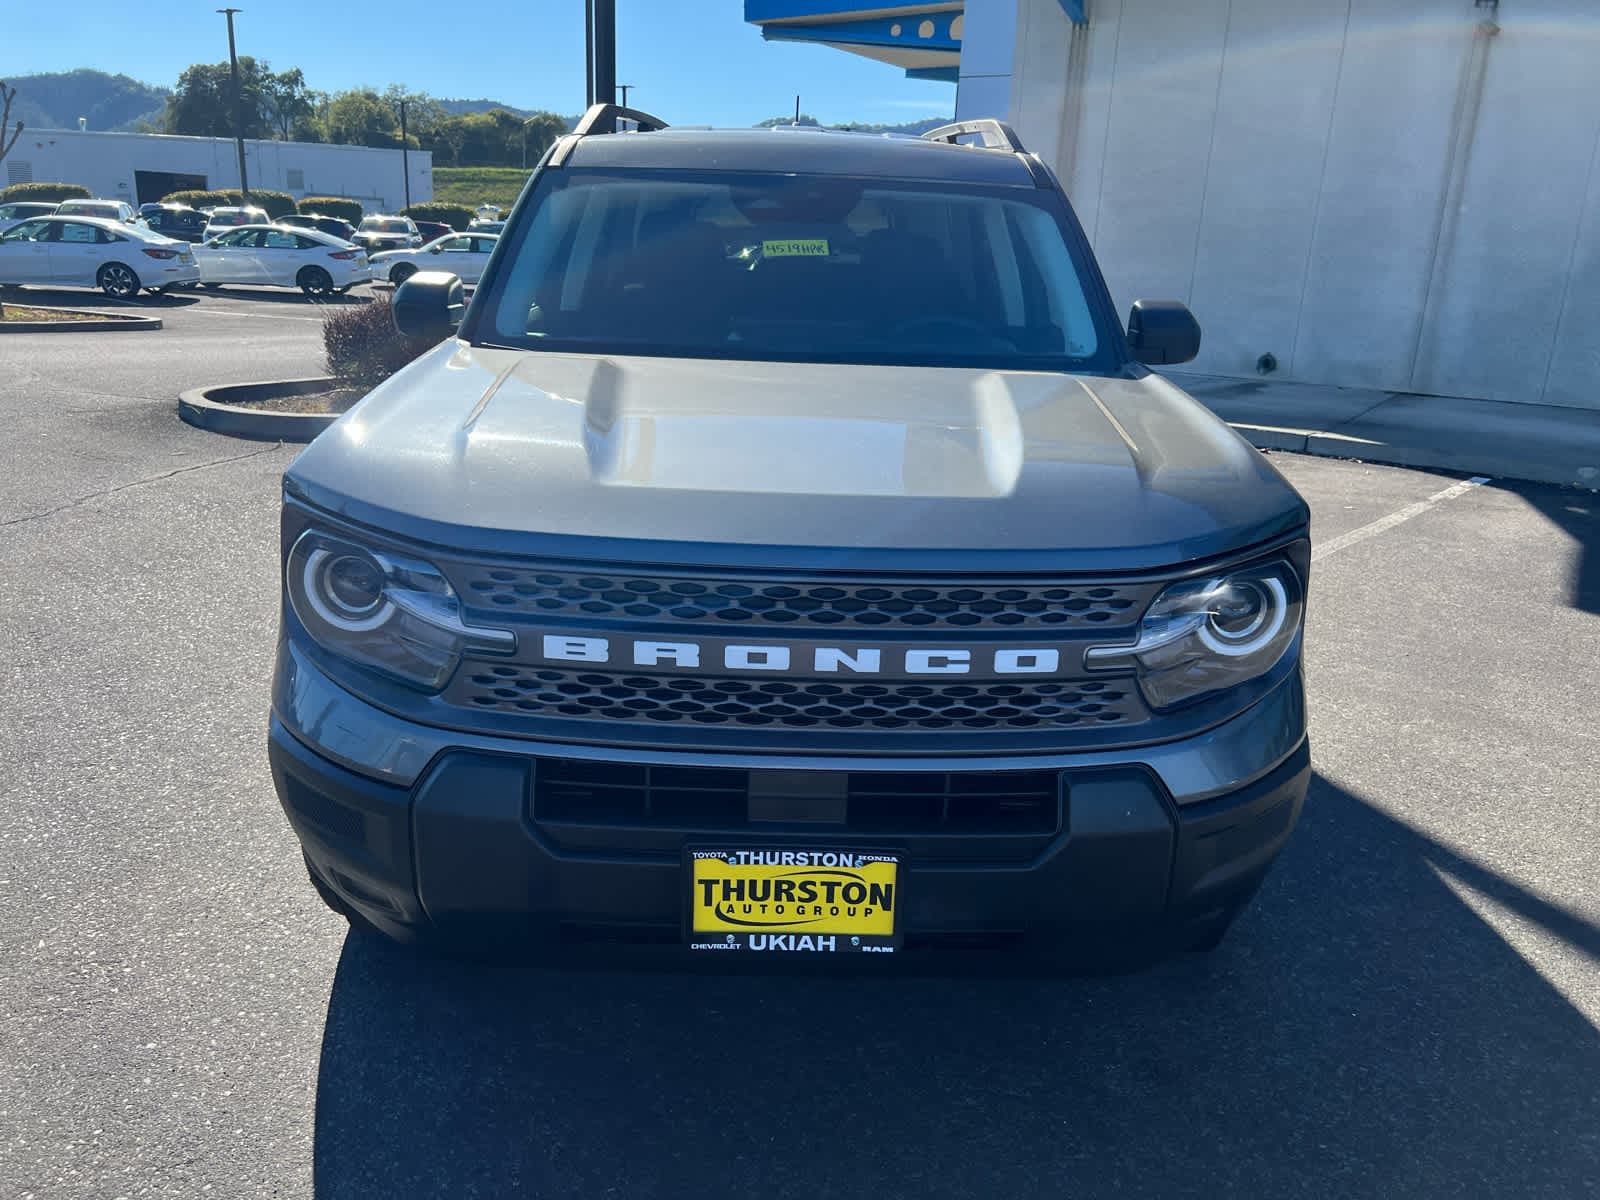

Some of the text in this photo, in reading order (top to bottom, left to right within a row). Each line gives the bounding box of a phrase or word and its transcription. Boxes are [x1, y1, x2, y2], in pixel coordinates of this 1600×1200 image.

[542, 634, 1059, 674] BRONCO
[693, 851, 728, 859] TOYOTA
[735, 851, 853, 868] THURSTON
[698, 879, 893, 911] THURSTON
[749, 934, 836, 952] UKIAH
[862, 945, 894, 953] RAM
